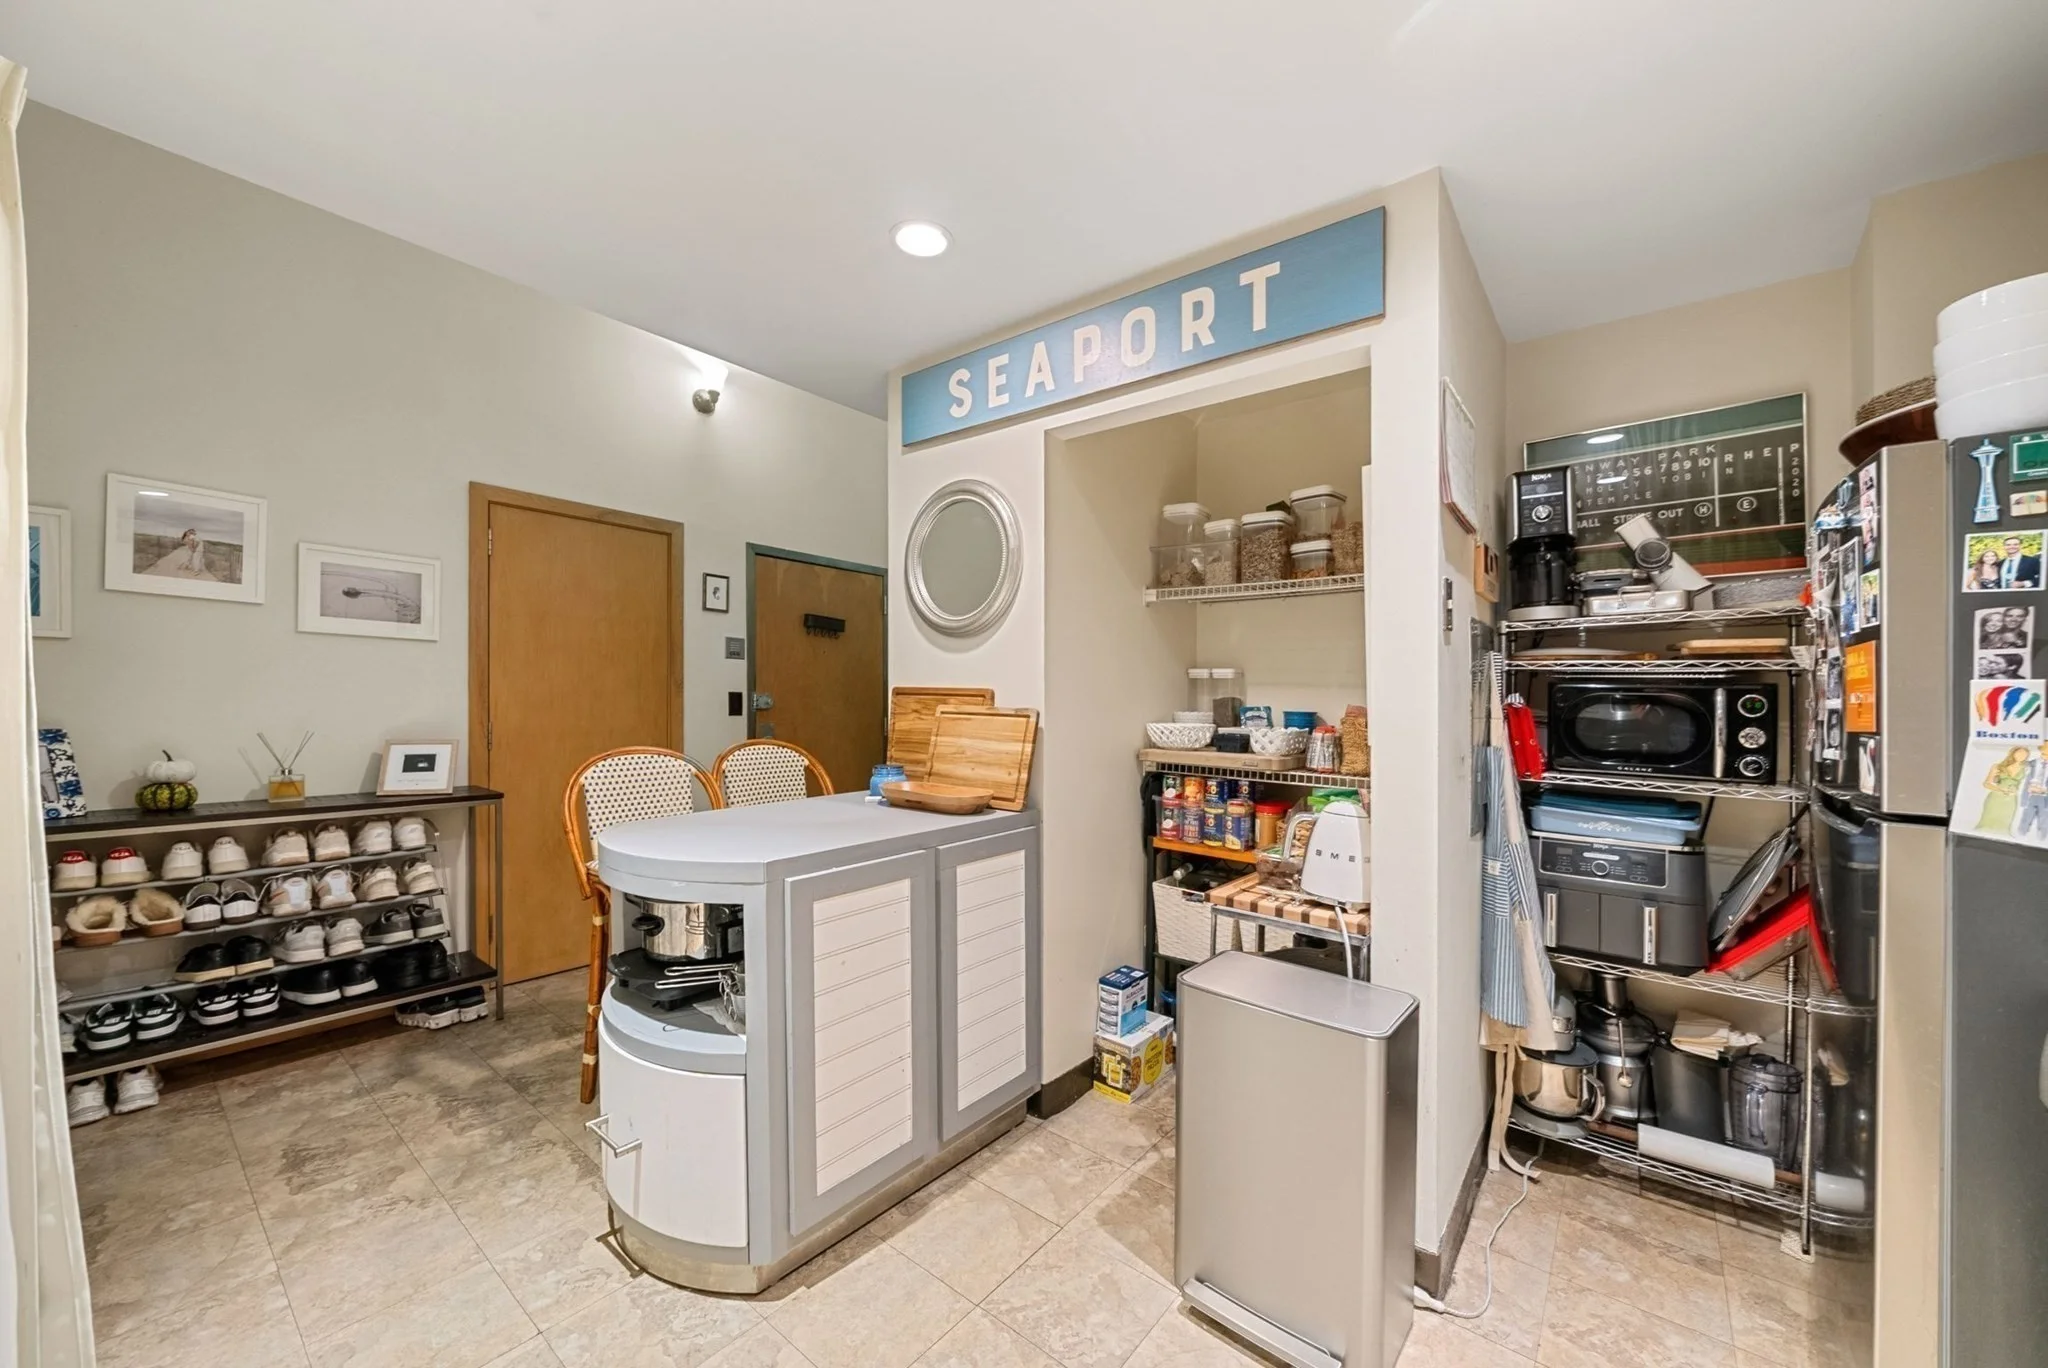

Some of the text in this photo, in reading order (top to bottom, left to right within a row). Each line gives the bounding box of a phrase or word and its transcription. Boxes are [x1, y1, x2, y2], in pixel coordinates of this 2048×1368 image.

[948, 261, 1281, 418] SEAPORT
[1657, 444, 1716, 461] PARK
[1789, 442, 1800, 453] P
[1632, 467, 1641, 477] 5
[1643, 465, 1653, 475] 6
[1660, 463, 1667, 473] 7
[1671, 462, 1680, 471] 8
[1682, 460, 1692, 470] 9
[1698, 457, 1711, 467] 10
[1723, 453, 1734, 463] R
[1743, 449, 1754, 460] H
[1762, 447, 1772, 457] E
[1587, 491, 1653, 507] TEMPLE
[1657, 507, 1684, 519] OUT
